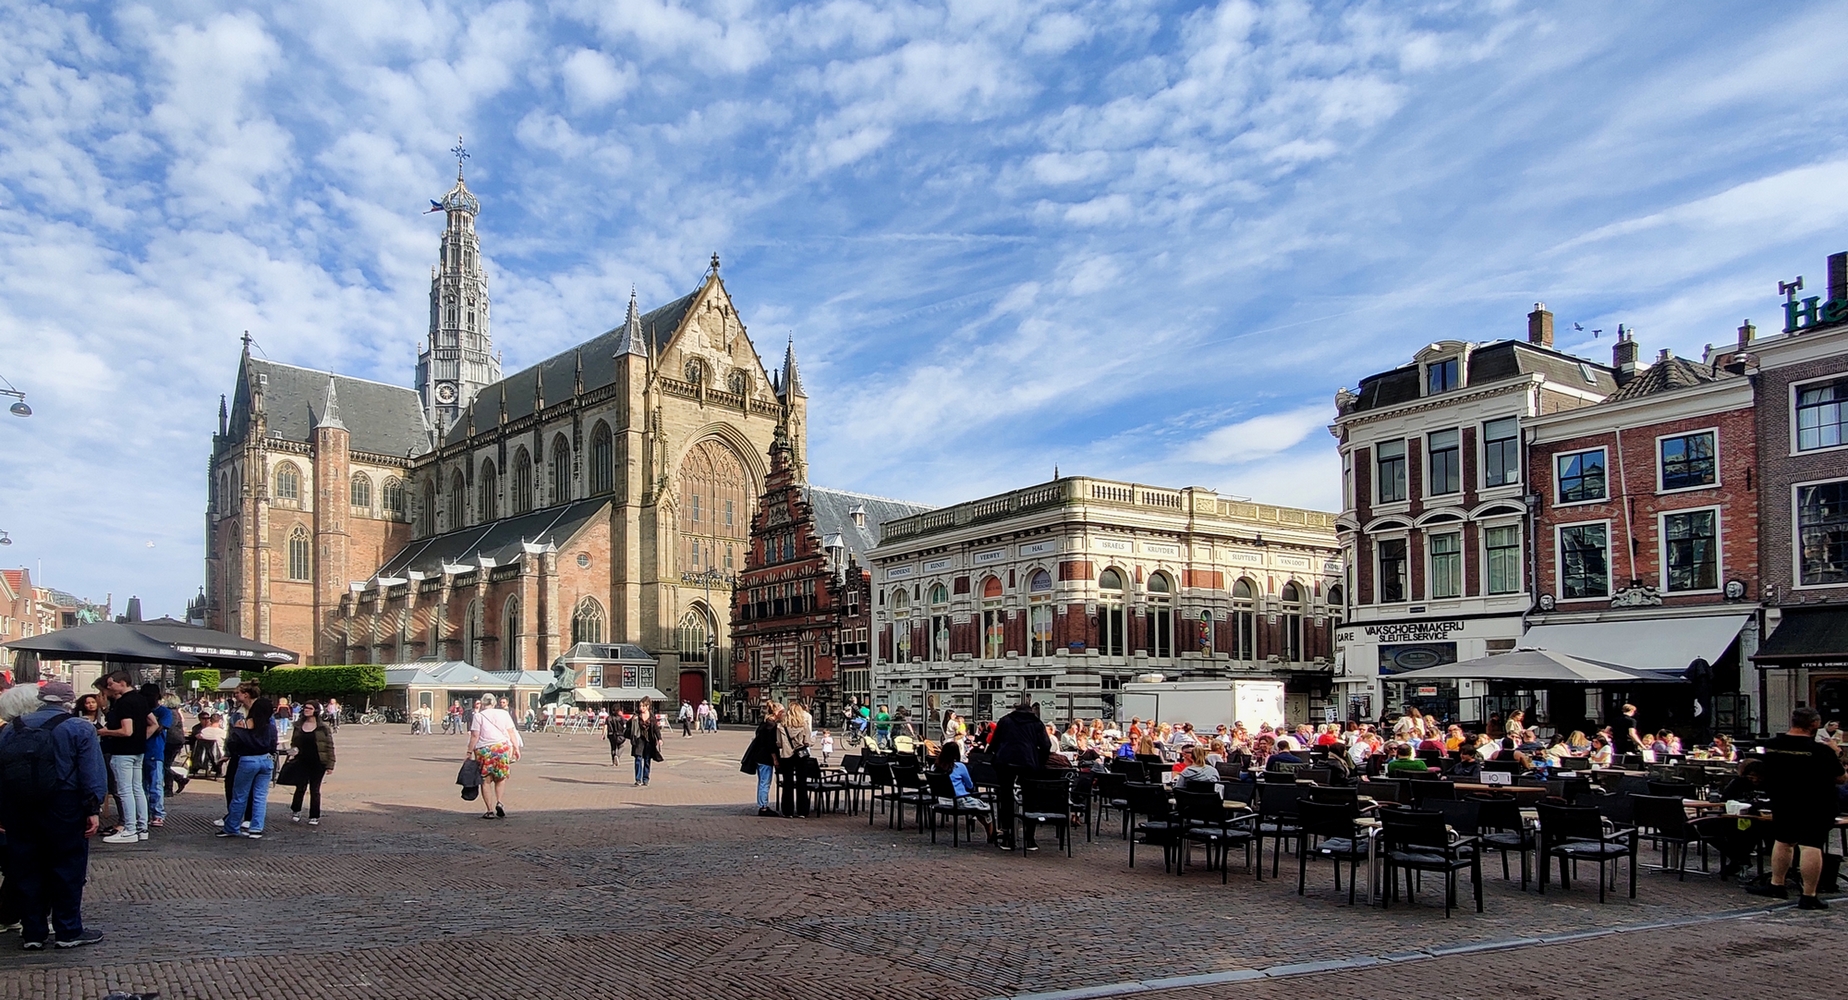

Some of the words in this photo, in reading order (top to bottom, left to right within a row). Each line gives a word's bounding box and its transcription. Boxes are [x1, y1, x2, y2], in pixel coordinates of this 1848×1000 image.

[1101, 541, 1125, 550] ISRAELS
[1147, 546, 1175, 555] KRUYDER
[979, 552, 1001, 561] VERWEY
[1231, 554, 1258, 562] SLUYTERS
[930, 561, 946, 569] KUNST
[890, 568, 911, 576] MODERNE
[1365, 621, 1464, 635] VAKSCHOENMAKERIJ
[1337, 632, 1355, 643] CARE
[1378, 631, 1448, 643] SLEUTELSERVICE
